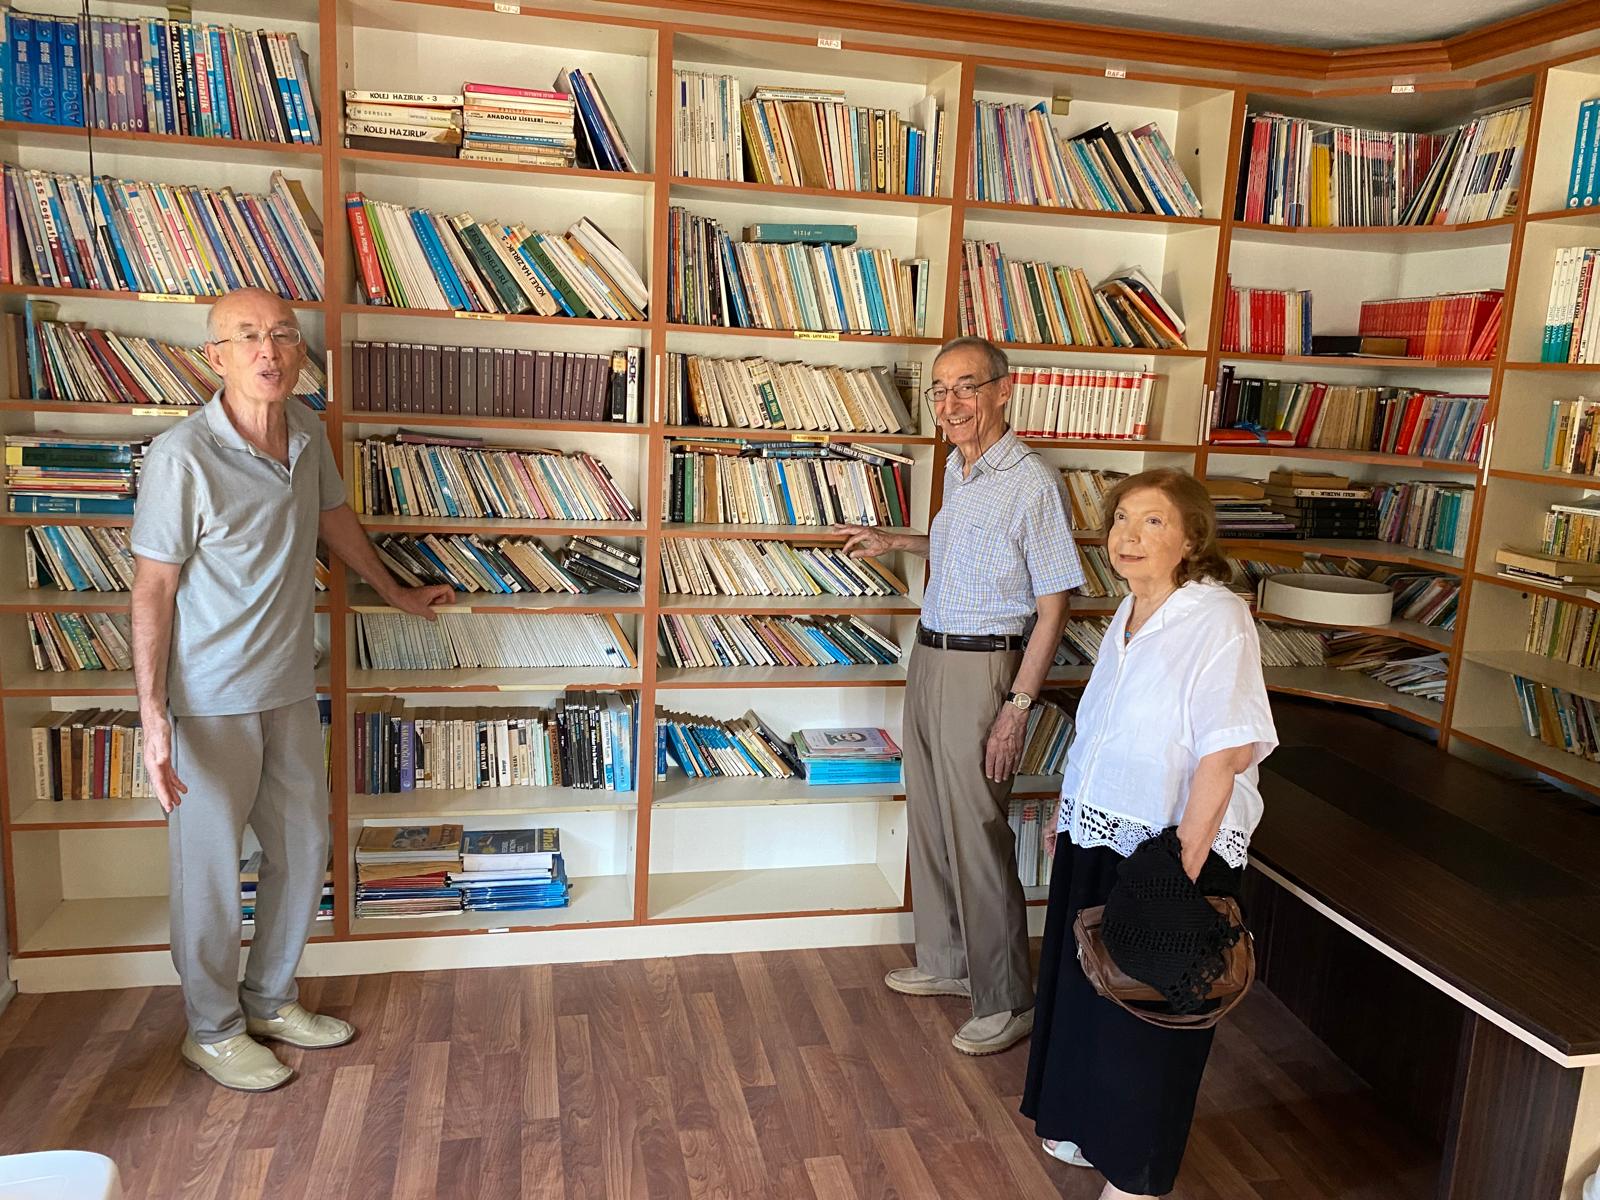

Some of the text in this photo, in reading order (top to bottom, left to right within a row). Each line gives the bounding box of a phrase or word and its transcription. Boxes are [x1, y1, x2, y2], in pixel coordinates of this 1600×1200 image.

[171, 41, 186, 97] MATEMATİK-2
[183, 41, 194, 79] MATEMATİK
[195, 55, 210, 110] Matematik
[363, 126, 387, 135] KOLEJ
[487, 113, 517, 121] ANADOLU
[519, 115, 544, 123] LİSELERİ
[468, 227, 508, 286] FEN LİSELERİ
[507, 244, 532, 277] HAZIRLIK
[528, 276, 546, 297] KOLEJ
